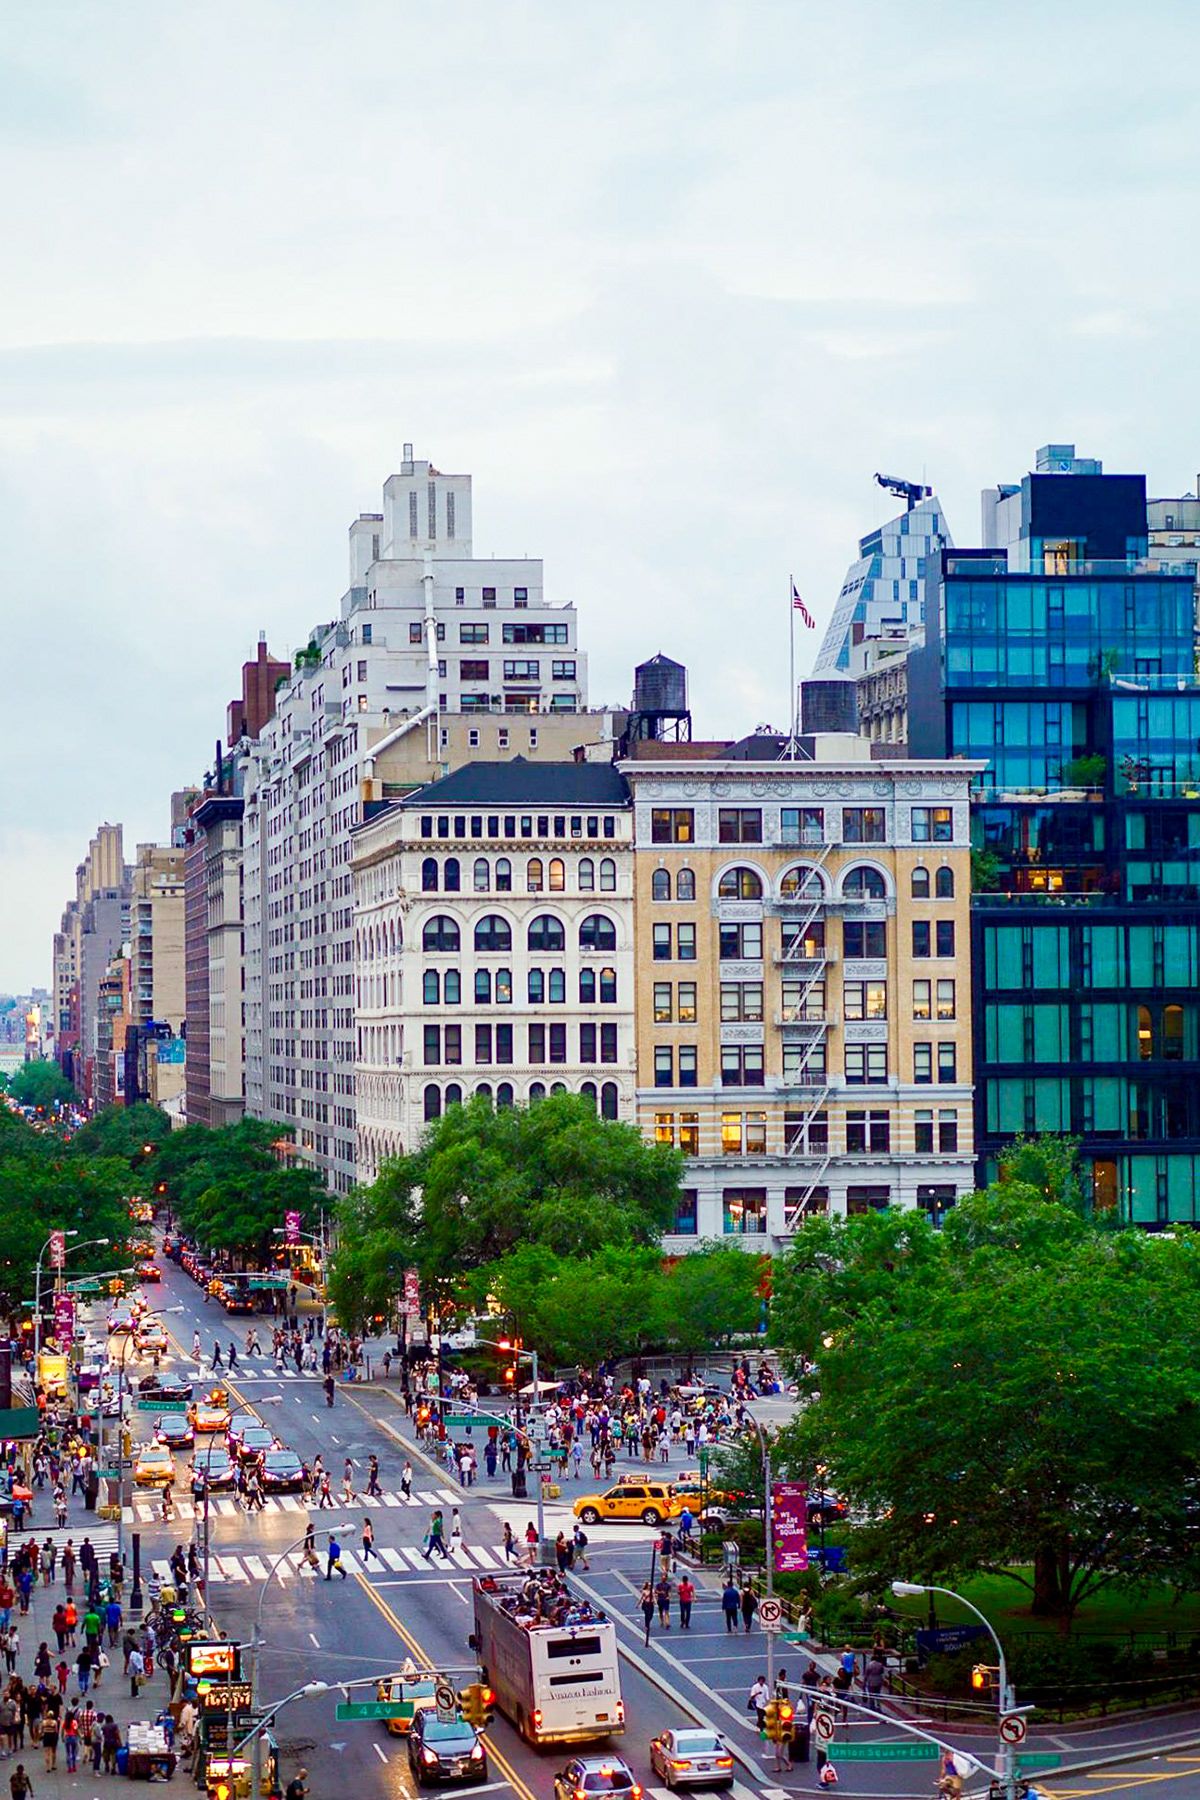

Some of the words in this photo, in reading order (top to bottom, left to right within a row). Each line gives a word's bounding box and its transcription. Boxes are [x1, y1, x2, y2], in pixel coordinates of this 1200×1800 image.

[780, 1528, 804, 1536] SQUARE
[360, 1705, 368, 1716] 4
[831, 1748, 865, 1756] Union
[867, 1748, 907, 1758] Square
[910, 1747, 934, 1756] East
